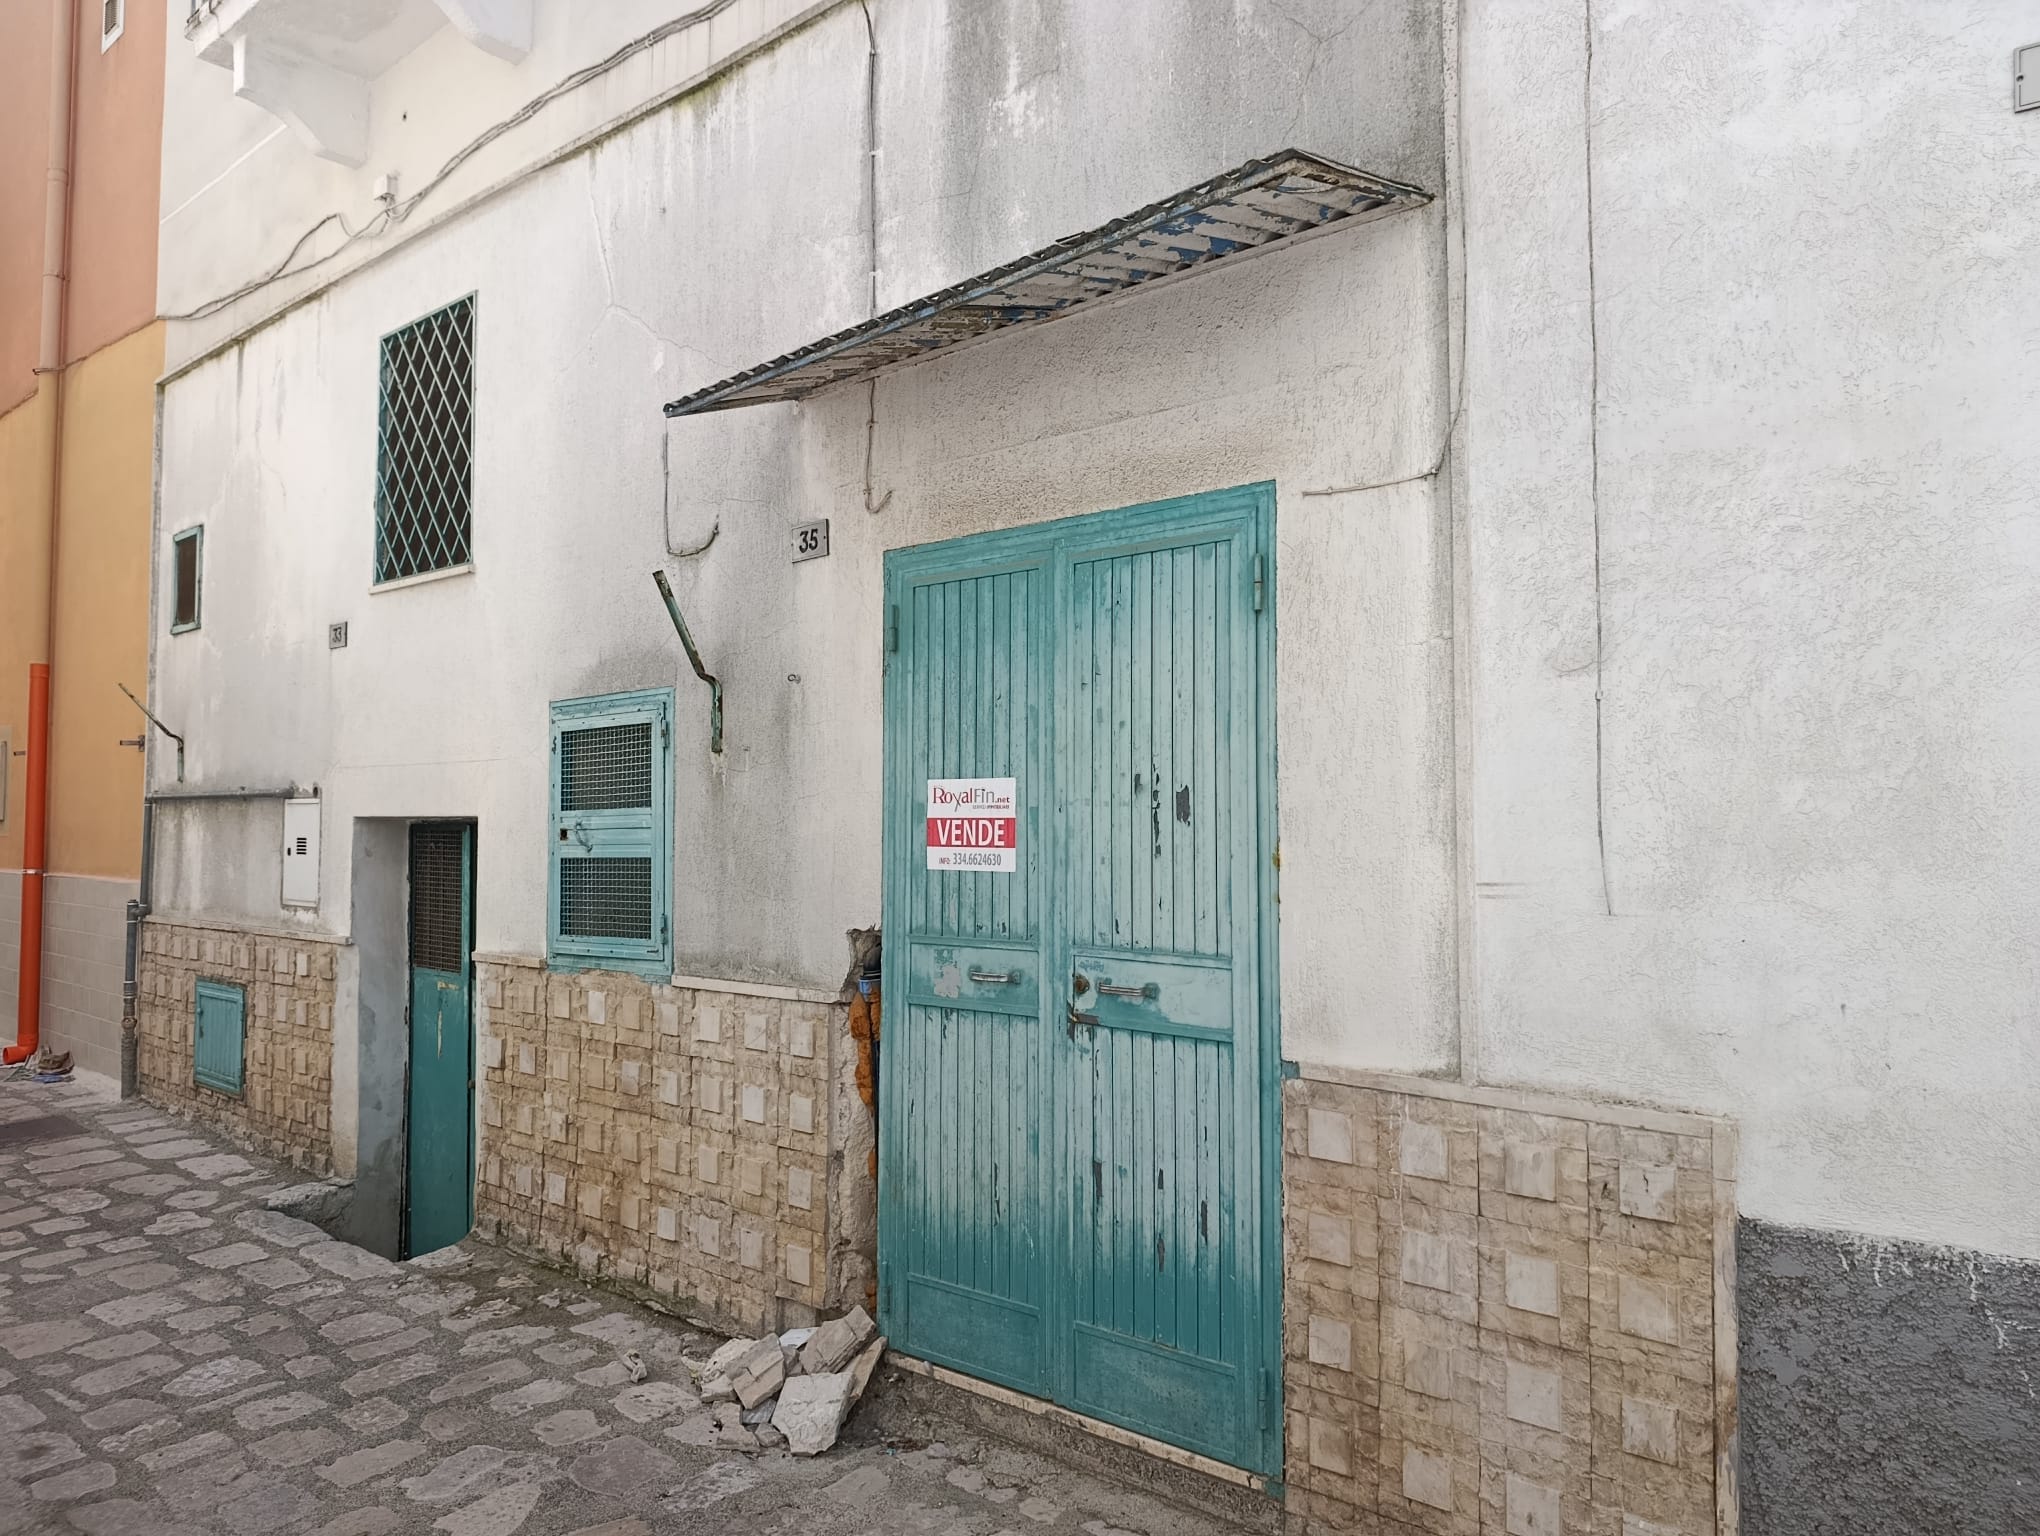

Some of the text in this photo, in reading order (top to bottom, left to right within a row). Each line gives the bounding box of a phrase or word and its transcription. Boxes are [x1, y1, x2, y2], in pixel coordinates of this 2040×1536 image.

[799, 528, 818, 553] 35
[332, 626, 342, 643] 33
[936, 819, 1005, 847] VENDE
[952, 853, 1002, 866] 334.6624630
